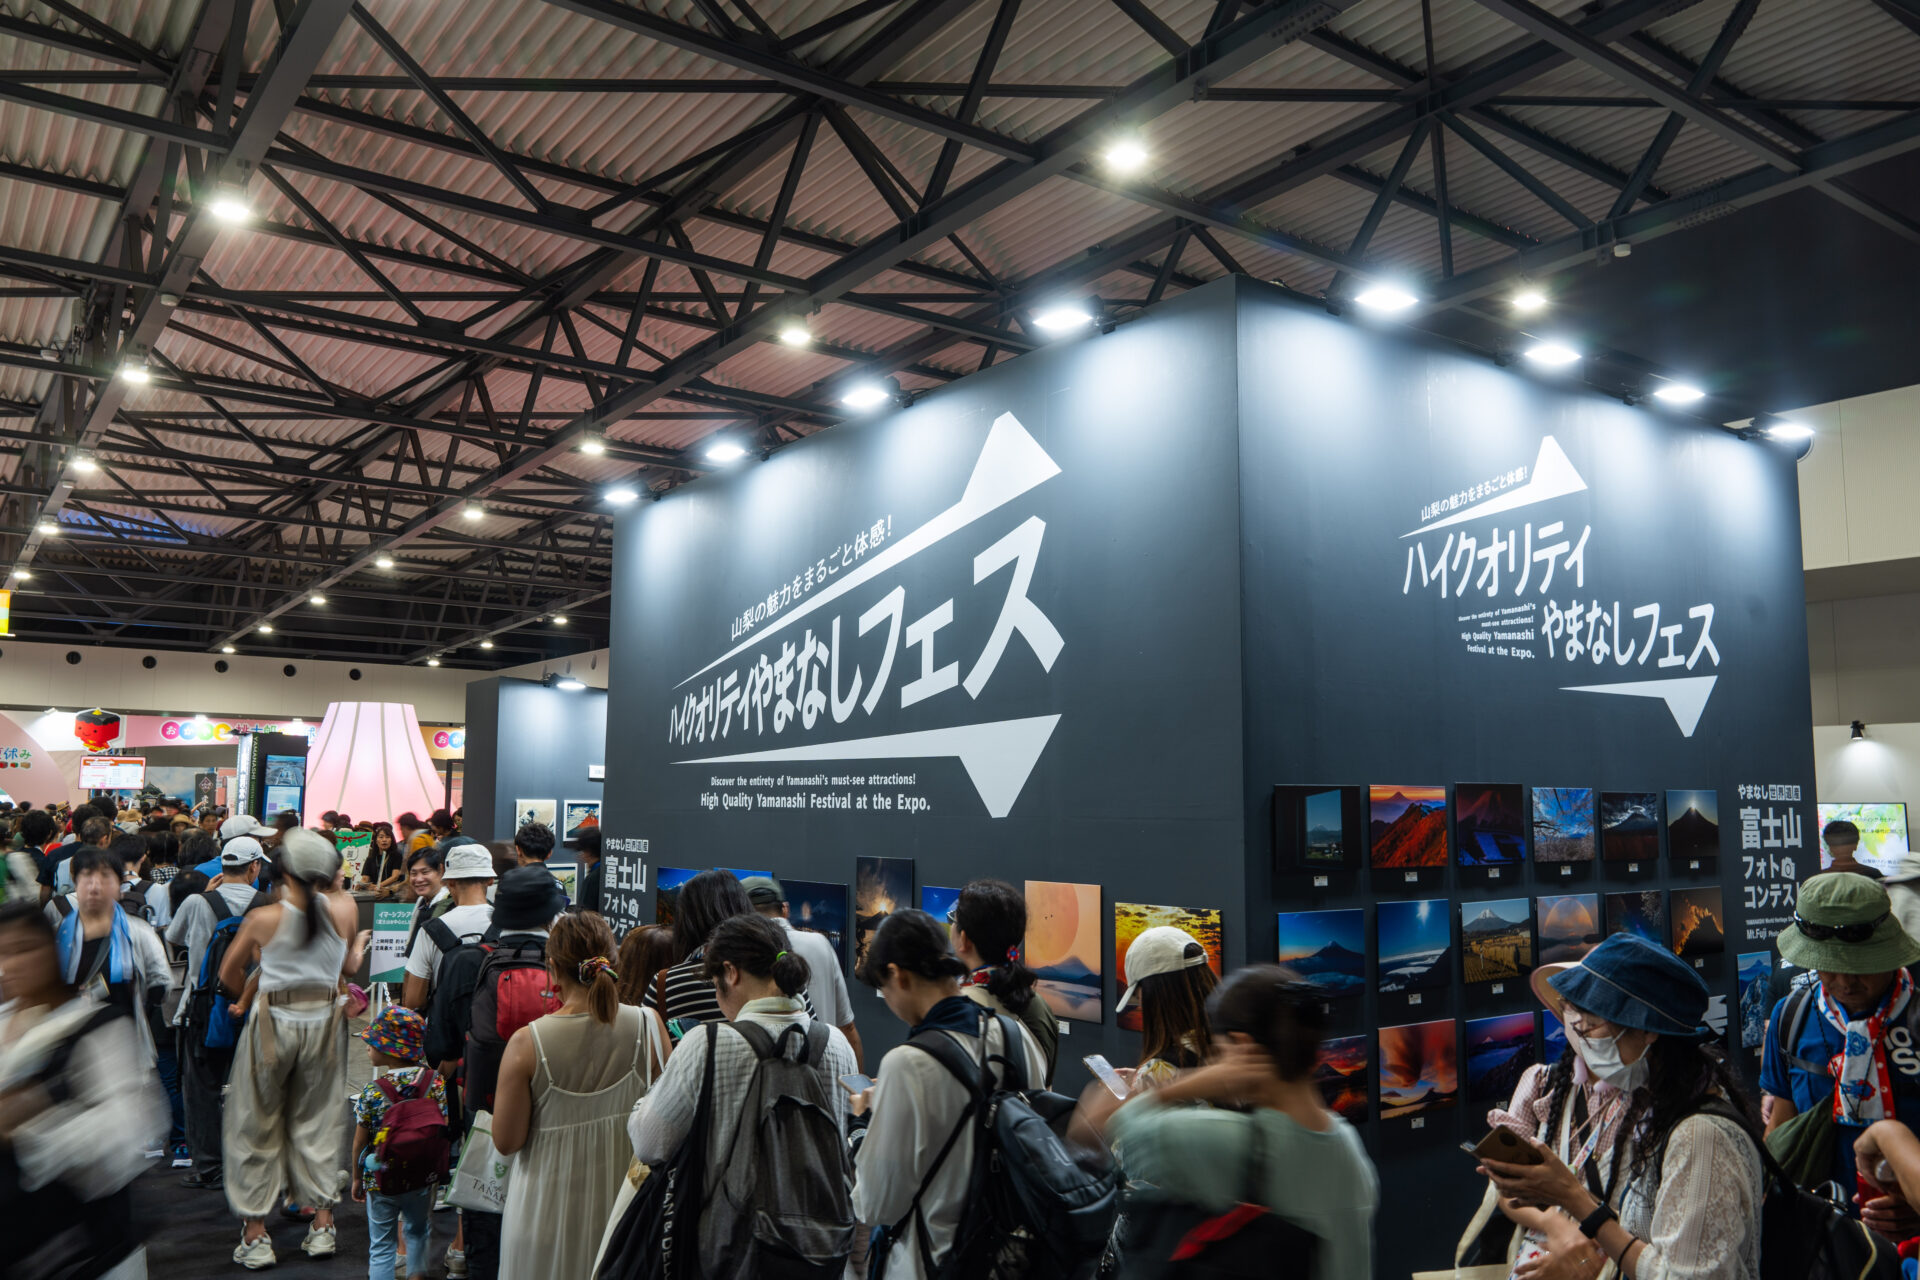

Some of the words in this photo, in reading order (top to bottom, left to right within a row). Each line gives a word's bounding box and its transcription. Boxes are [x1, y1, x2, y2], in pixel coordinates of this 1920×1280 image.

[1402, 520, 1592, 599] ハイクオリティ
[731, 514, 893, 641] 山梨の魅力をまるごと体感!
[1500, 602, 1536, 615] Yamanashi's
[1500, 615, 1534, 626] attractions!
[668, 515, 1066, 746] ハイクオリティやまなしフェス
[1461, 631, 1472, 642] High
[1472, 631, 1492, 642] Quality
[1493, 628, 1535, 640] Yamanashi
[1541, 599, 1721, 671] やまなしフェス
[1467, 644, 1487, 654] Festival
[1488, 646, 1495, 655] at
[1496, 646, 1509, 656] the
[1511, 647, 1535, 660] Expo.
[0, 747, 32, 760] 休み
[251, 736, 259, 780] YAMANASHI
[710, 776, 736, 787] Discover
[737, 775, 747, 786] the
[749, 775, 775, 788] entirety
[777, 775, 784, 786] of
[786, 774, 829, 786] Yamanashi's
[831, 774, 866, 786] must-see
[868, 772, 917, 785] attractions!
[700, 792, 719, 810] High
[722, 792, 754, 811] Quality
[756, 792, 806, 809] Yamanashi
[810, 792, 852, 809] Festival
[856, 795, 868, 810] at
[872, 793, 892, 810] the
[897, 793, 931, 814] Expo.
[1739, 805, 1803, 850] 富士山
[604, 854, 647, 893] 富士山
[1742, 853, 1780, 880] フォト
[603, 893, 628, 914] フォト
[473, 1178, 506, 1204] TANAK
